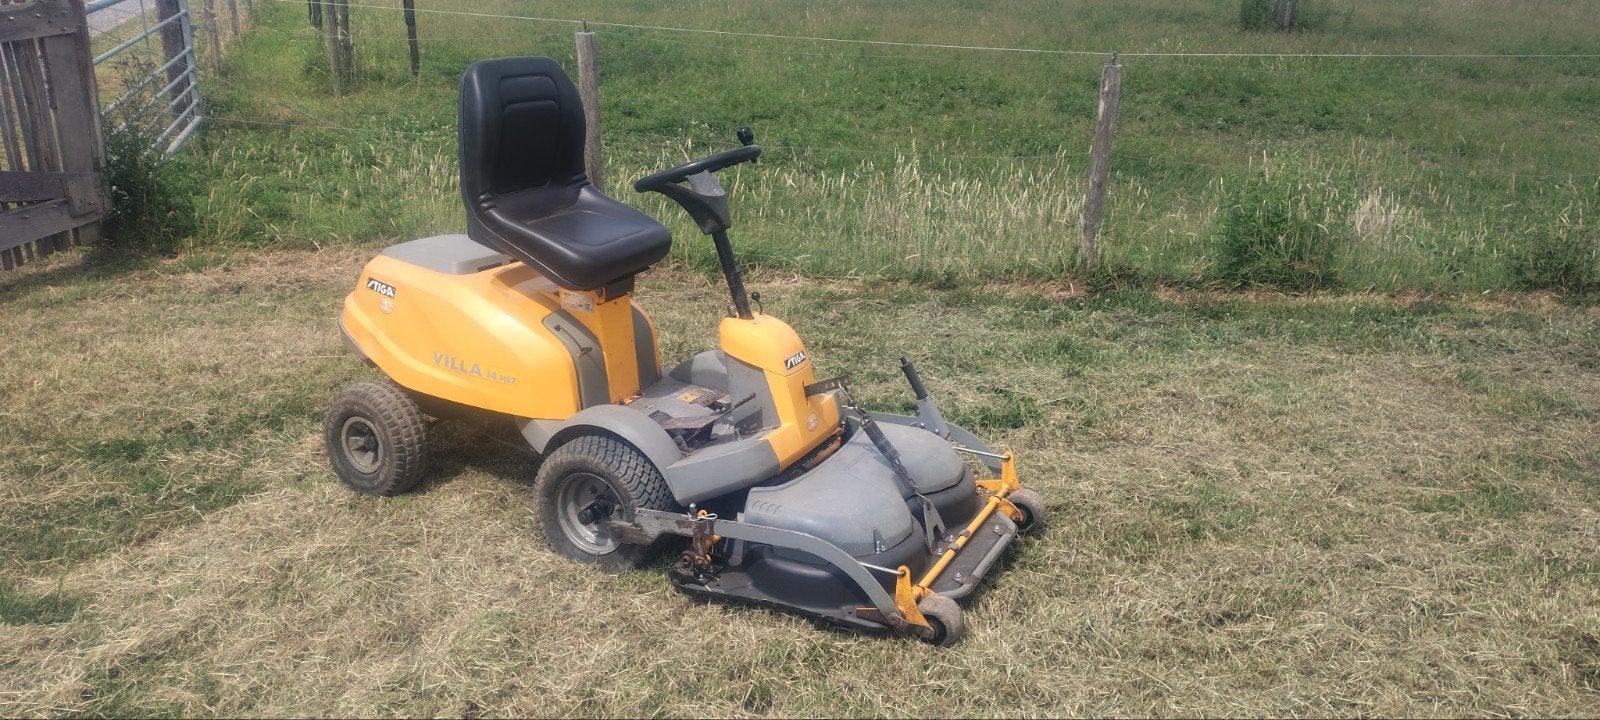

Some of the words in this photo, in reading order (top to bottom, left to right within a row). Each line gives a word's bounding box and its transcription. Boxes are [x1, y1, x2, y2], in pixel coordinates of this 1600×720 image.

[367, 280, 394, 298] STIGA
[433, 352, 481, 377] VILLA
[487, 370, 497, 380] 14
[787, 352, 805, 370] STIGA
